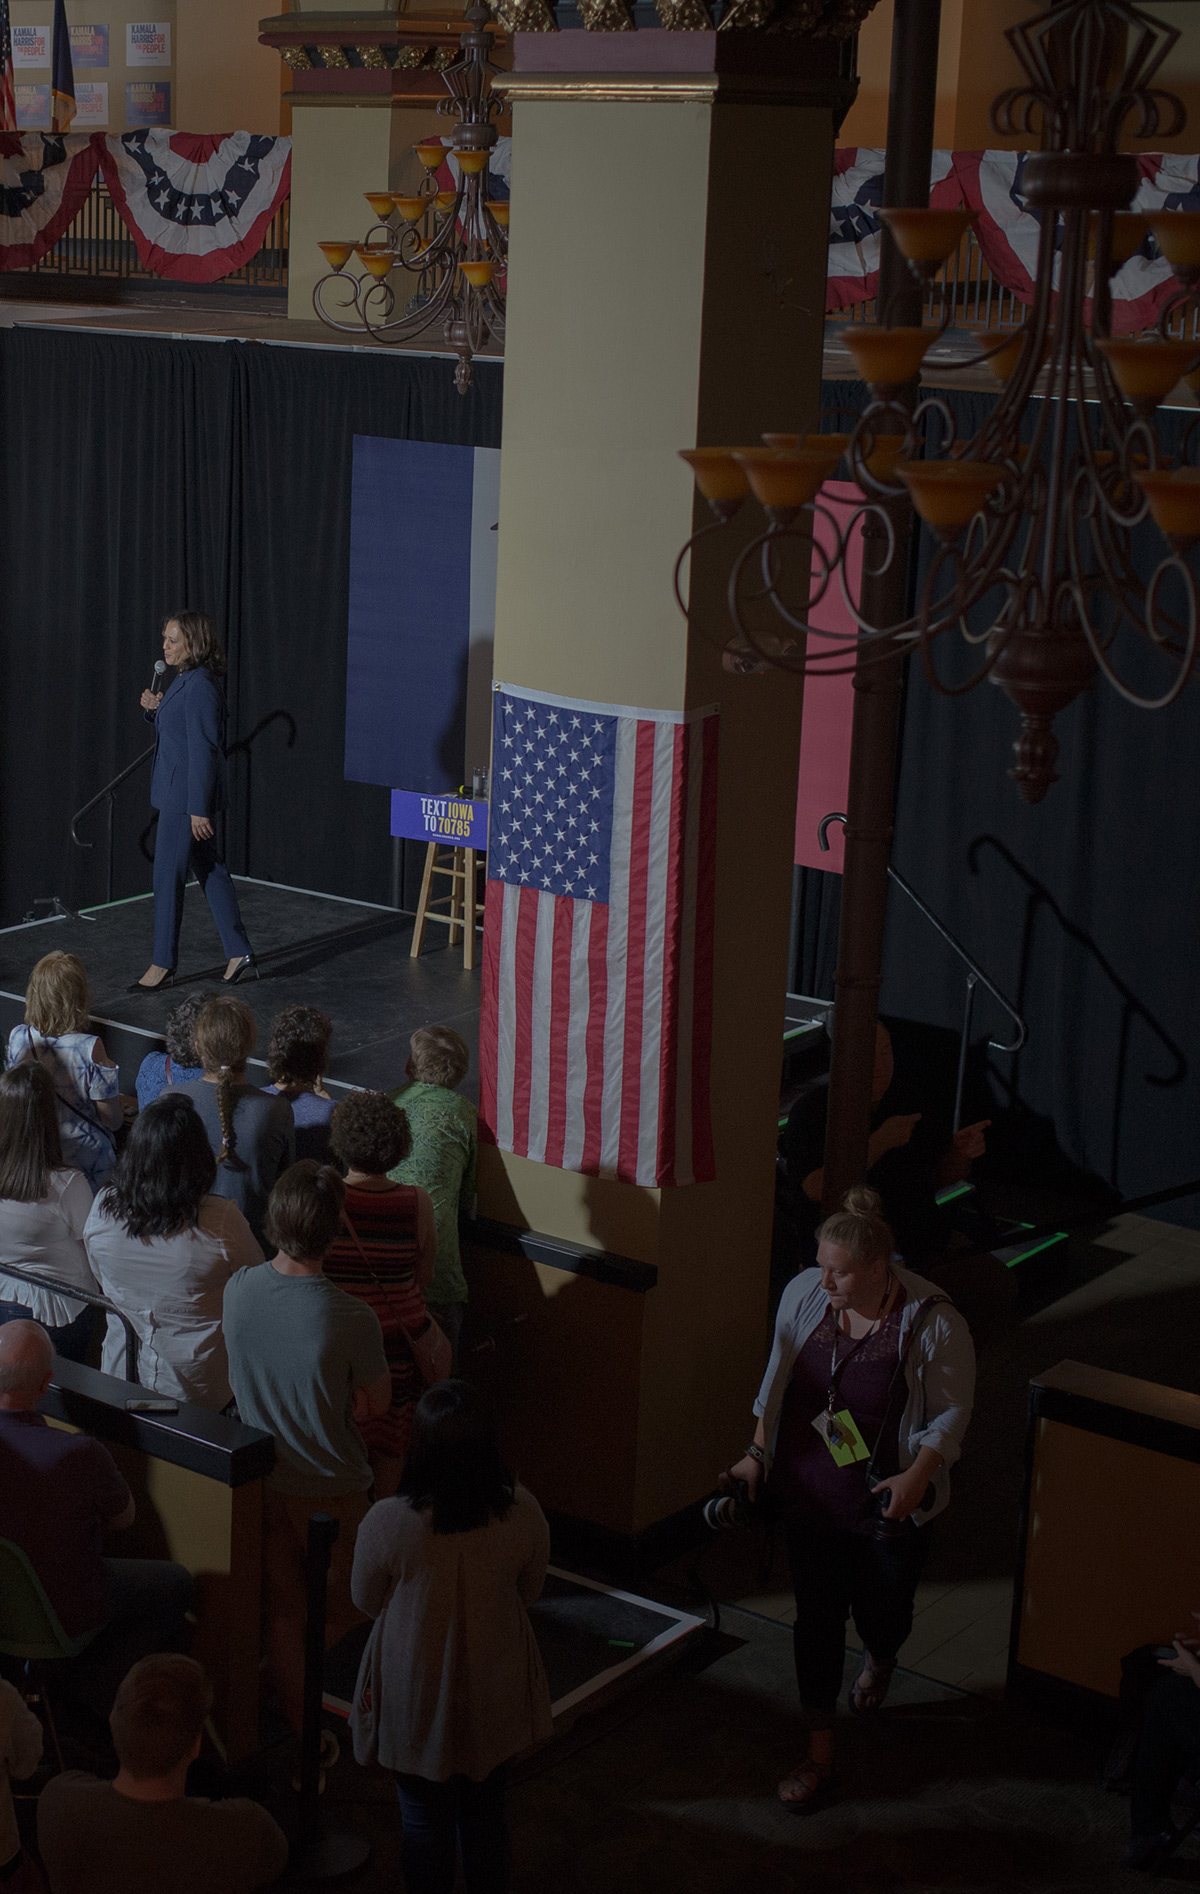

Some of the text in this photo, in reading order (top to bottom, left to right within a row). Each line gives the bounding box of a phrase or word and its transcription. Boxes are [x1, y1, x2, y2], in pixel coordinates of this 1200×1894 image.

[131, 24, 156, 33] KAMALA
[132, 34, 165, 43] HARRIS FOR
[24, 47, 45, 55] PEOPLE
[143, 44, 165, 53] PEOPLE
[420, 798, 474, 821] TEXT IOWA
[424, 815, 470, 837] TO 70785
